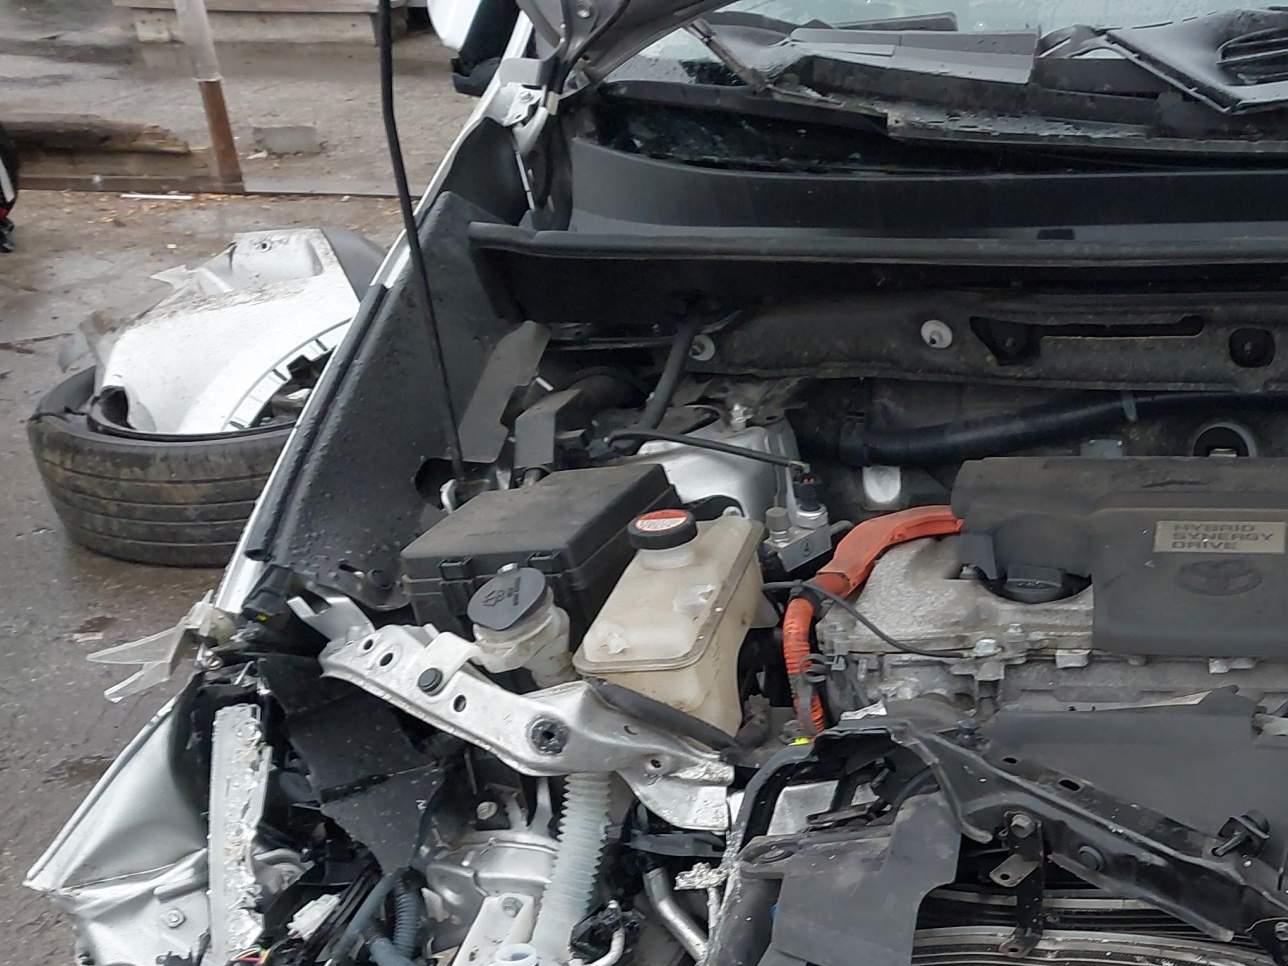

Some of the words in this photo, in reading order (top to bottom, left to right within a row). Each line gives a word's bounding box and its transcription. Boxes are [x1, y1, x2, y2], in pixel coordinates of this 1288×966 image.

[1173, 523, 1256, 533] HYBRID
[1172, 532, 1275, 542] SYNERGY
[1170, 541, 1237, 550] DRIVE
